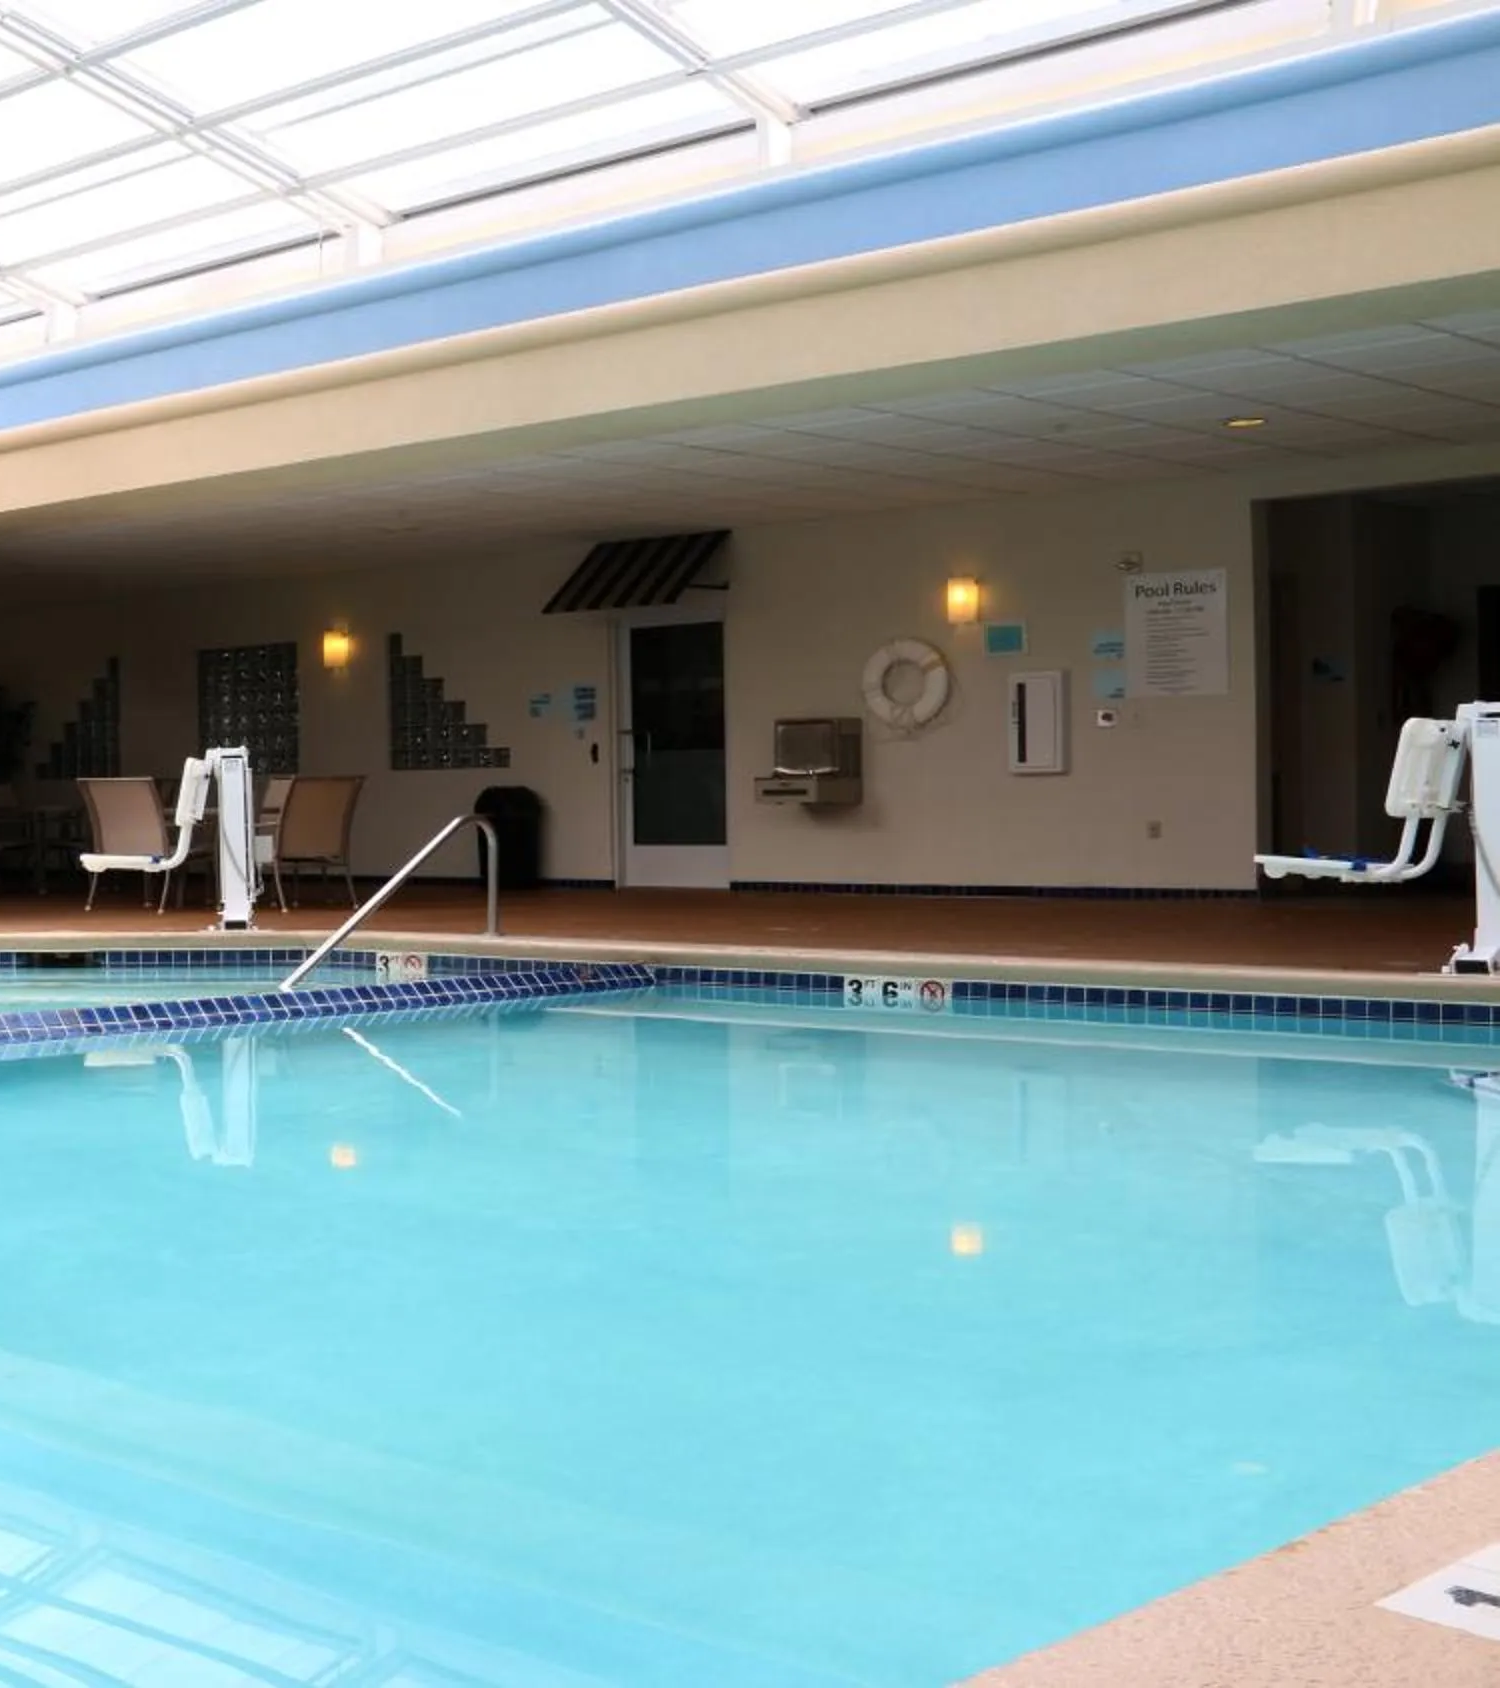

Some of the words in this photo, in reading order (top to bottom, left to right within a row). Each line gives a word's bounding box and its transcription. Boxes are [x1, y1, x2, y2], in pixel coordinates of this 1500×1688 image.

[1135, 583, 1169, 598] Pool
[1173, 580, 1216, 595] Rules
[847, 979, 863, 996] 3
[882, 981, 898, 998] 6
